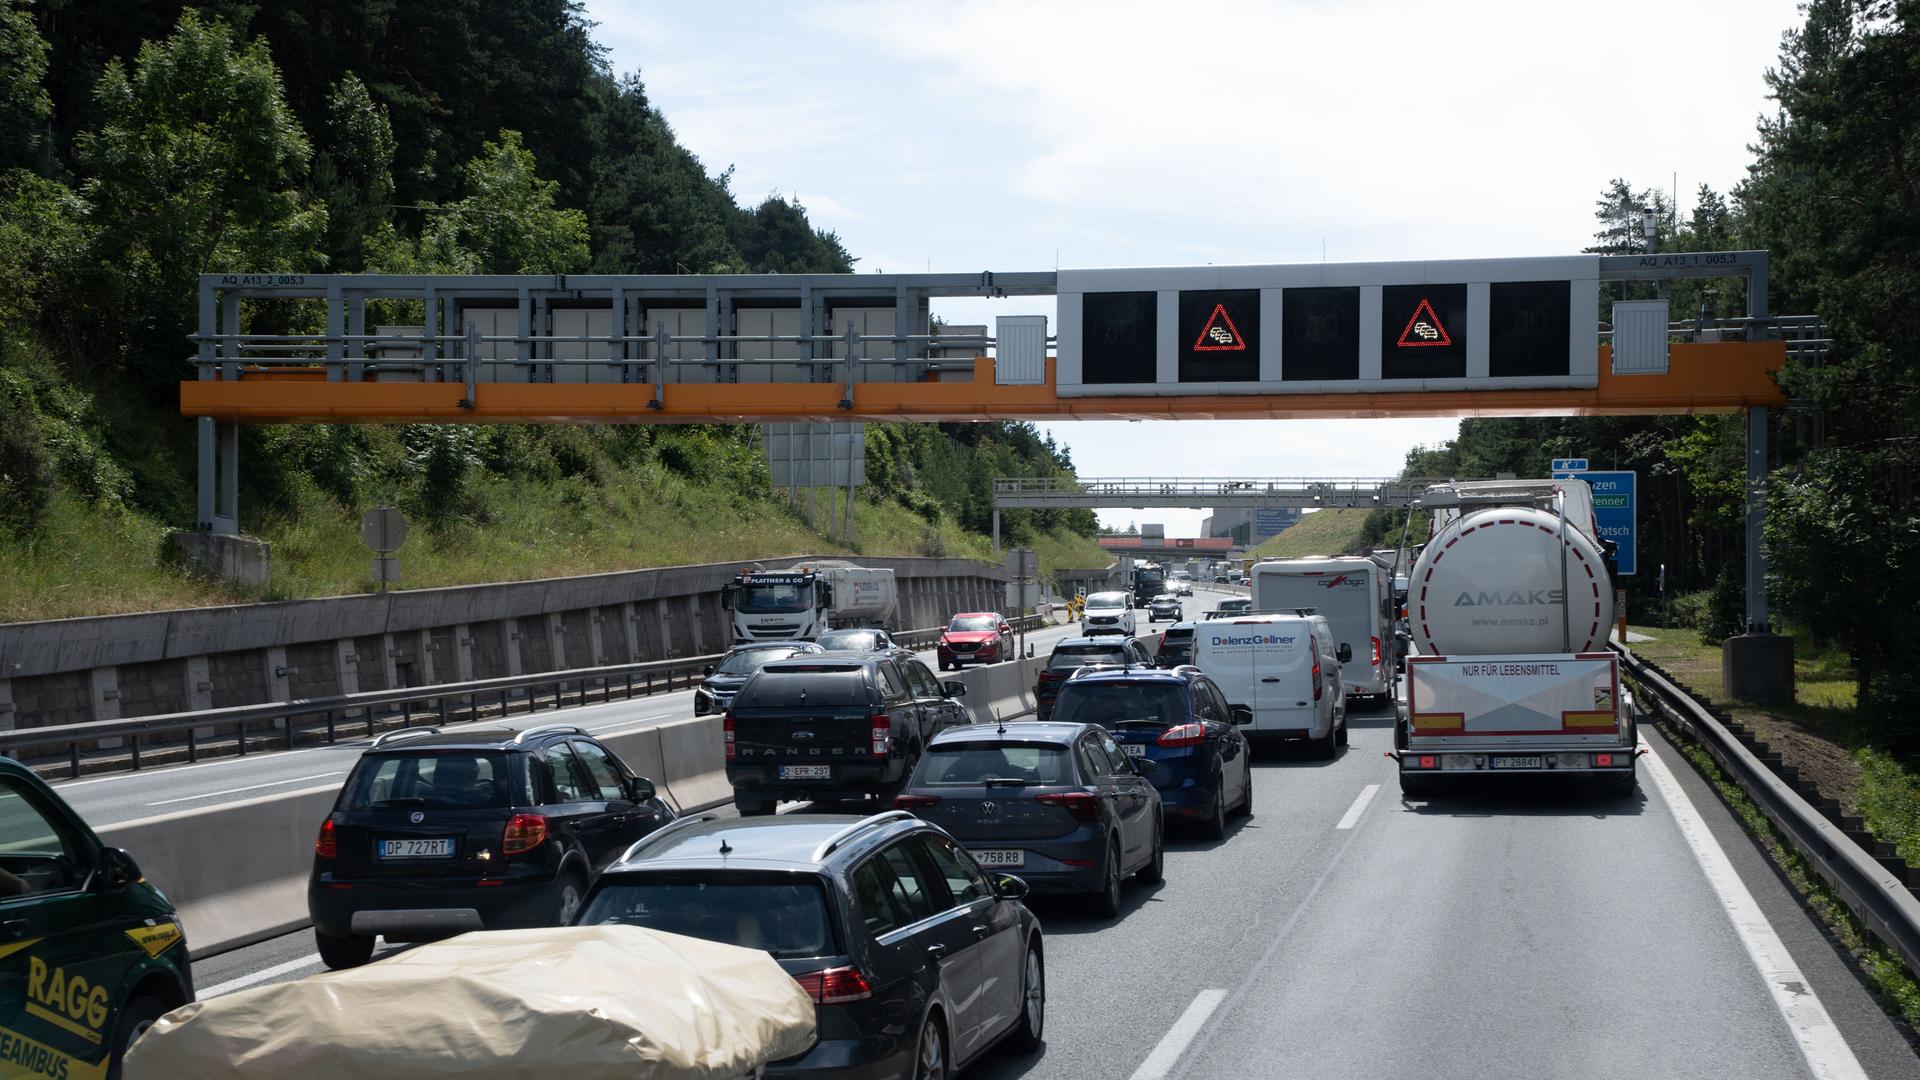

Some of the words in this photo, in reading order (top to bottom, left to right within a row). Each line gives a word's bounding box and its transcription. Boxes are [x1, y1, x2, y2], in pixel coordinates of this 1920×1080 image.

[1592, 482, 1616, 490] zen
[1592, 498, 1624, 506] renner
[1597, 525, 1629, 536] Patsch
[1454, 590, 1564, 606] AMAKS
[1472, 617, 1549, 628] www.amaks.pl
[1462, 665, 1480, 676] NUR
[1481, 663, 1498, 676] FÜR
[1499, 664, 1560, 676] LEBENSMITTEL
[742, 747, 867, 756] RANGER
[28, 955, 108, 1028] RAGG
[0, 1031, 69, 1080] EAMBUS
